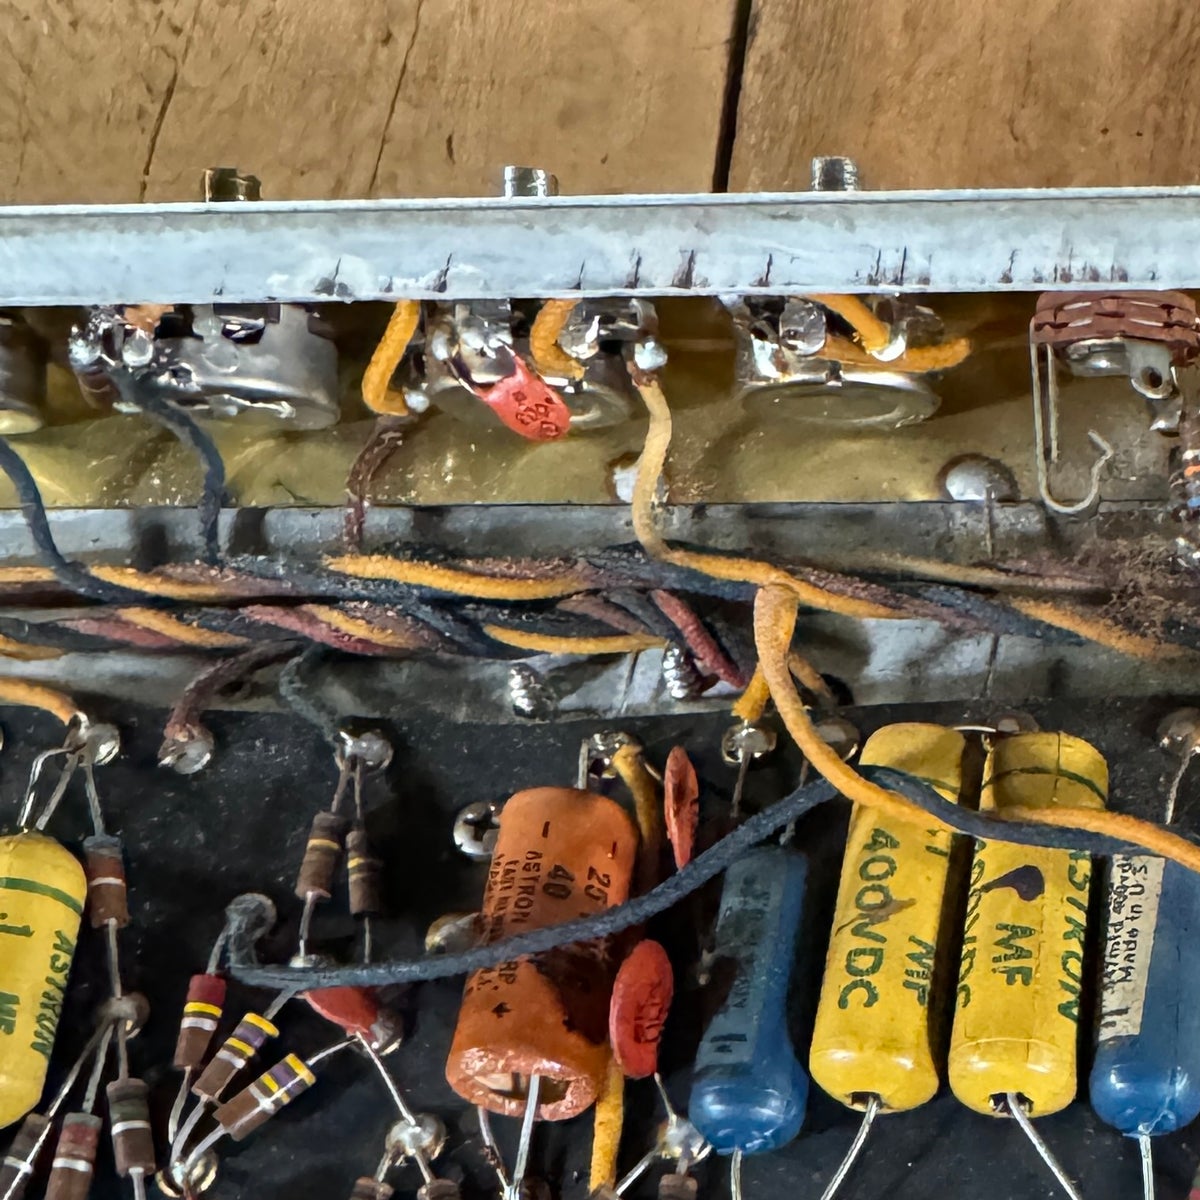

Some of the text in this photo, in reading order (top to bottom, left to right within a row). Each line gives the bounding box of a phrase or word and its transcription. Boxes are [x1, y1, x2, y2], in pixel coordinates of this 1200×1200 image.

[542, 863, 575, 899] 40
[837, 827, 900, 1009] 400VDC
[991, 922, 1036, 986] MF
